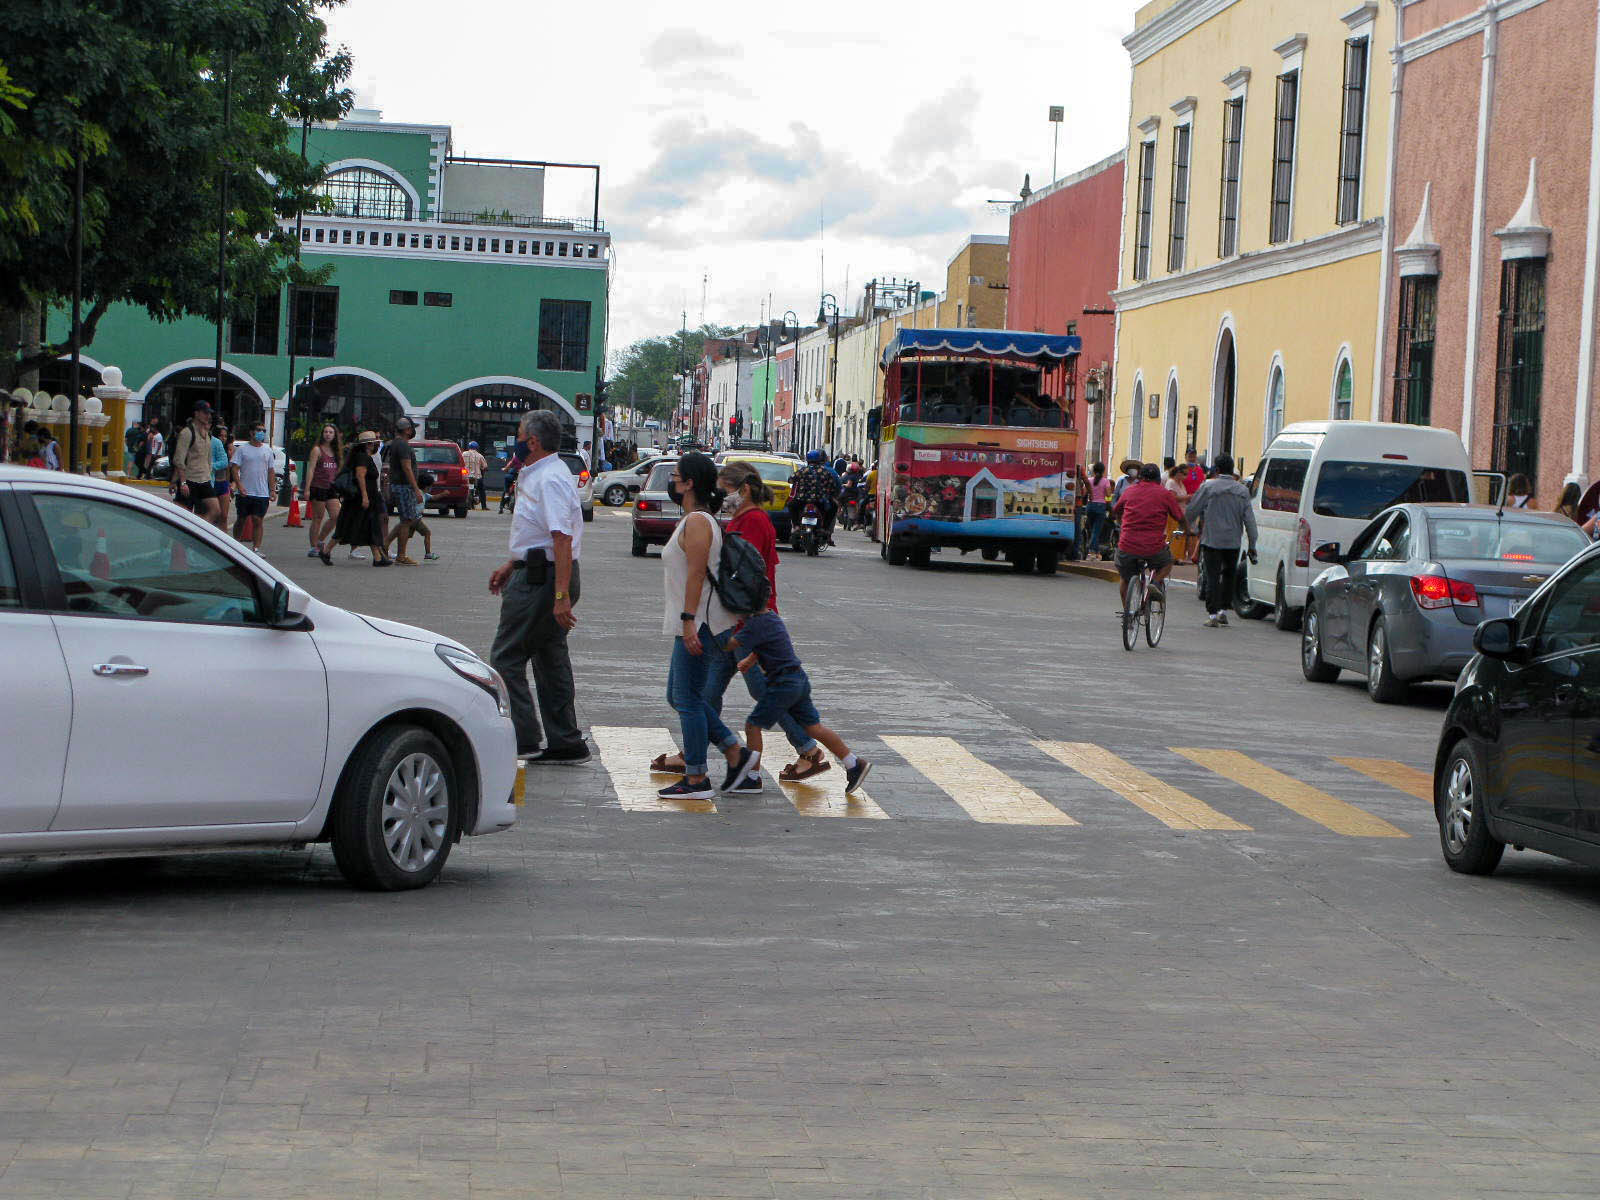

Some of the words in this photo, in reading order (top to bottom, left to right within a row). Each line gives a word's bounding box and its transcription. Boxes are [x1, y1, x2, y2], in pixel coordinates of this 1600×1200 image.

[1016, 438, 1059, 449] SIGHTSEEING
[944, 451, 1015, 465] ALLADLID
[1022, 457, 1038, 468] City
[1040, 457, 1059, 467] Tour
